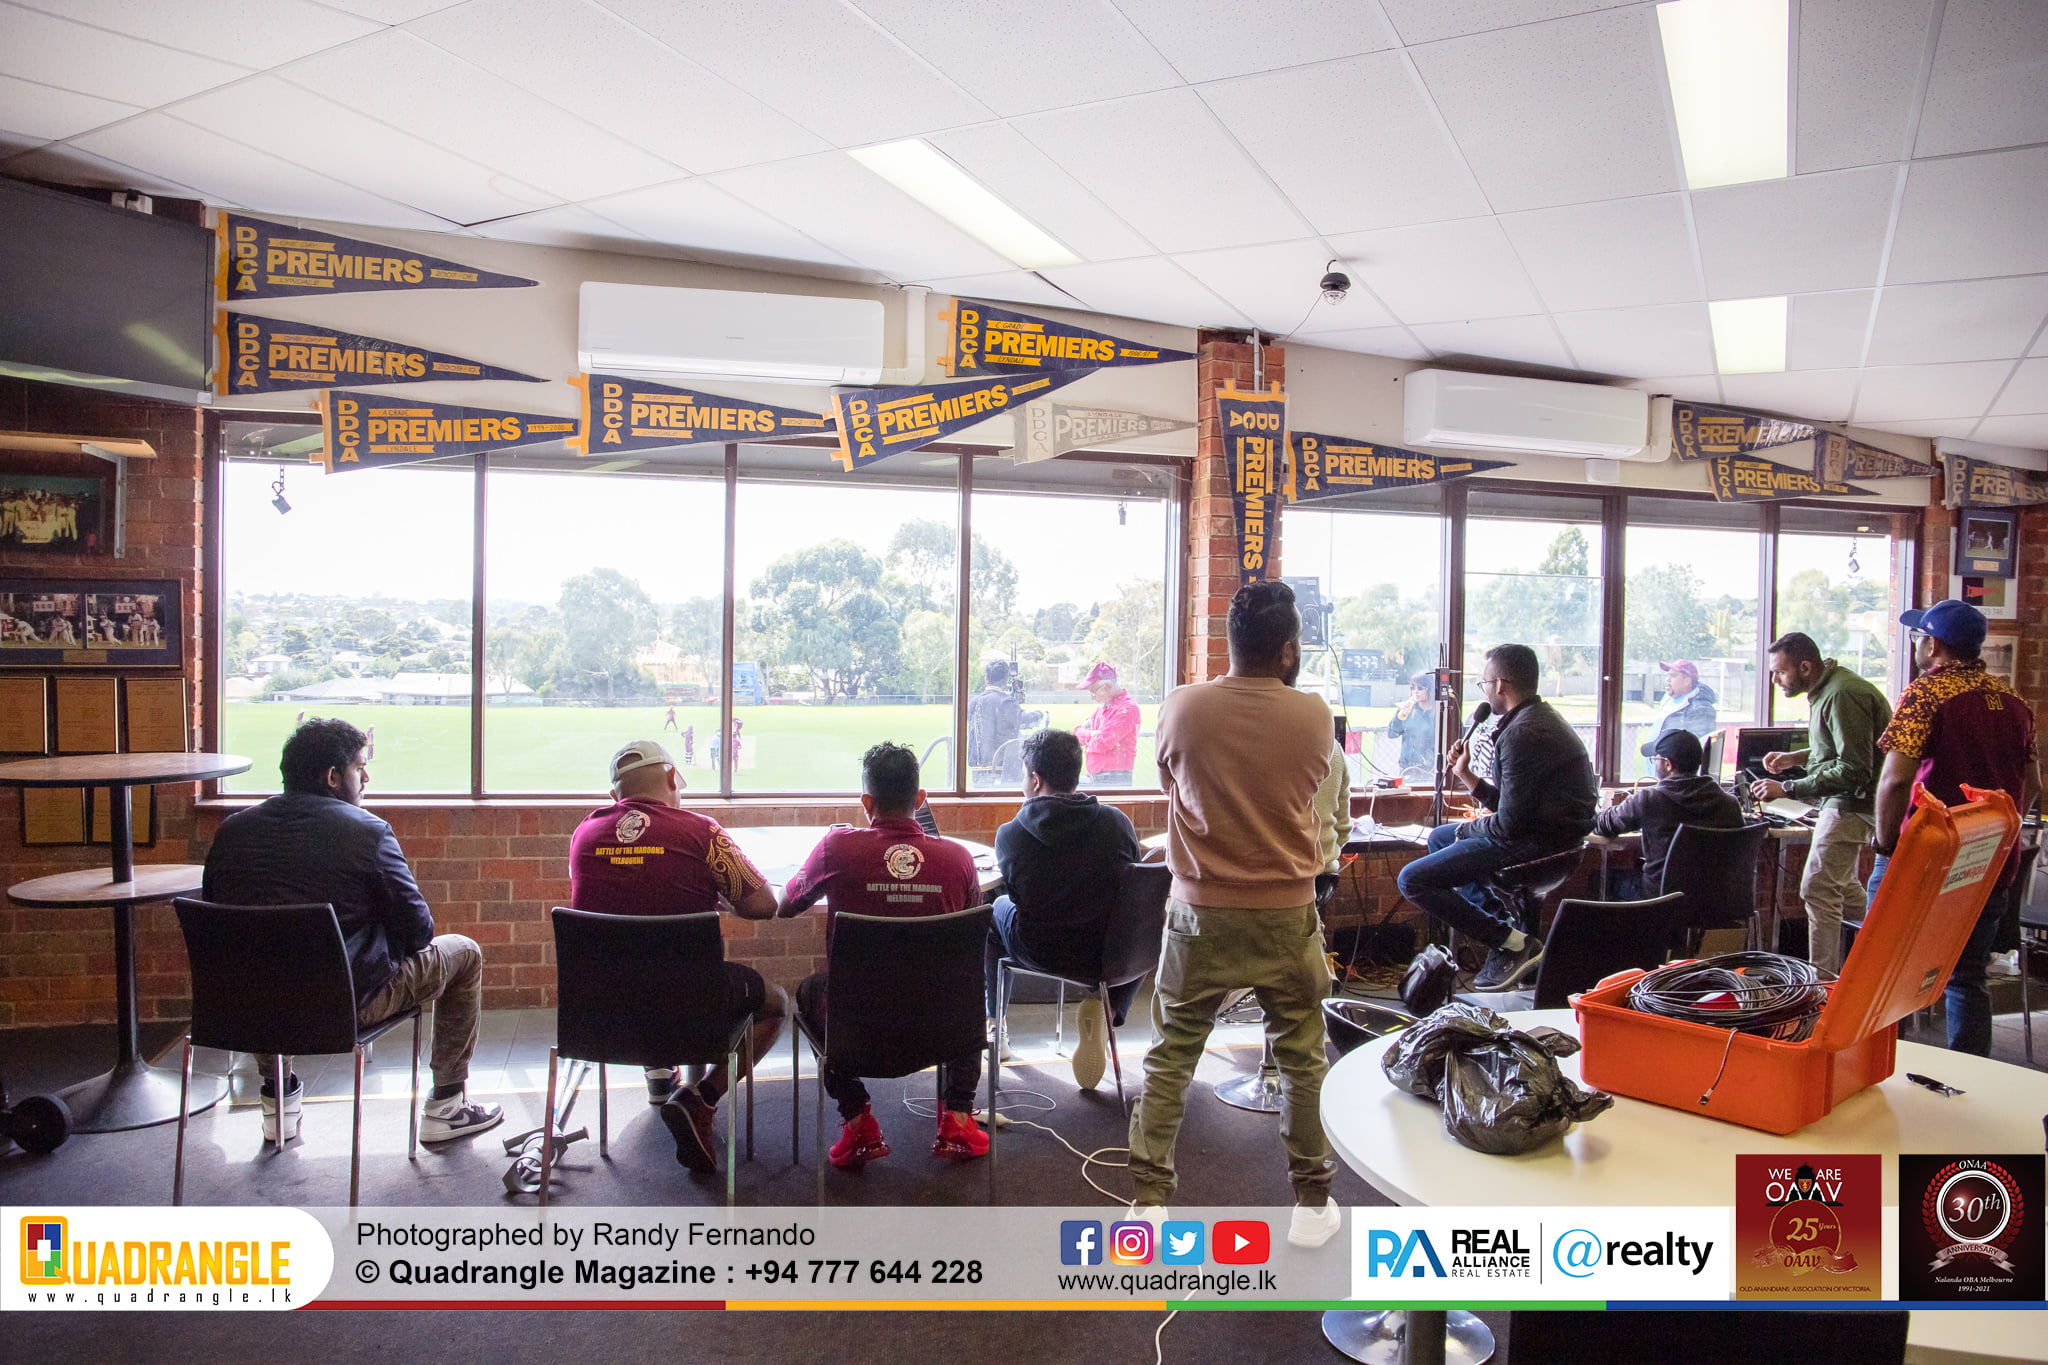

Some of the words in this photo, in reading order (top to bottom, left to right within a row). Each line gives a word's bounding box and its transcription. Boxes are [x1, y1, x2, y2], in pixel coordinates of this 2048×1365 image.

[267, 249, 423, 284] PREMIERS
[985, 330, 1115, 362] PREMIERS
[268, 344, 426, 378] PREMIERS
[631, 403, 775, 432] PREMIERS
[878, 385, 1008, 436] PREMIERS
[368, 417, 522, 442] PREMIERS
[1055, 414, 1148, 442] PREMIERS
[385, 445, 417, 453] LYNDALE
[1325, 455, 1435, 480] PREMIERS
[1734, 469, 1821, 493] PREMIERS
[1243, 436, 1265, 570] PREMIERS
[595, 847, 615, 855] BATTLE
[633, 846, 665, 855] MAROONS
[866, 883, 889, 892] BATTLE
[890, 884, 899, 892] OF
[901, 884, 911, 892] THE
[912, 884, 942, 893] MAROONS
